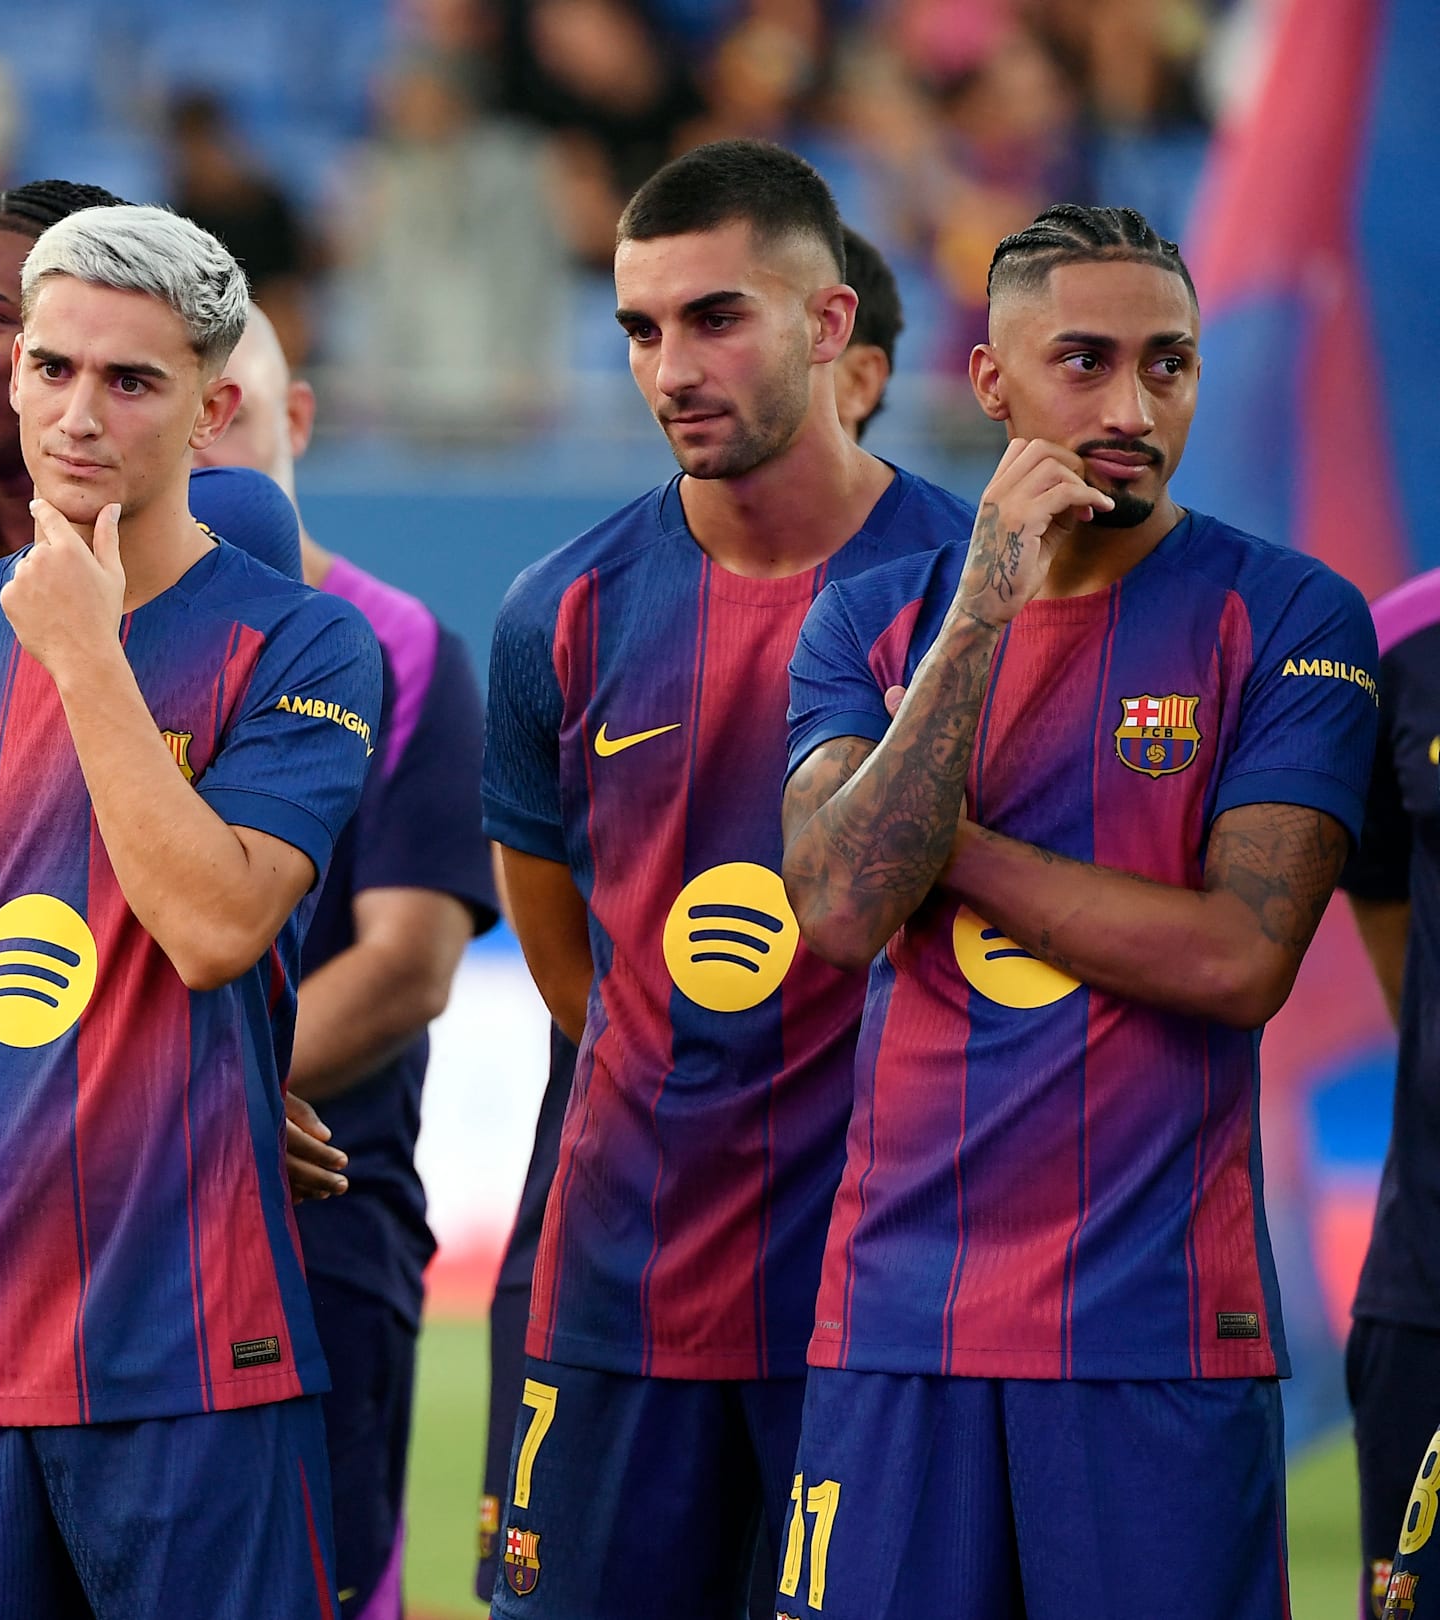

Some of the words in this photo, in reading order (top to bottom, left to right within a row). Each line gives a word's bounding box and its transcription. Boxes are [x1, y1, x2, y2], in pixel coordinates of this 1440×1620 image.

[1140, 727, 1174, 738] FCB
[513, 1378, 559, 1509] 7
[1398, 1430, 1440, 1555] 8
[779, 1471, 842, 1611] 11
